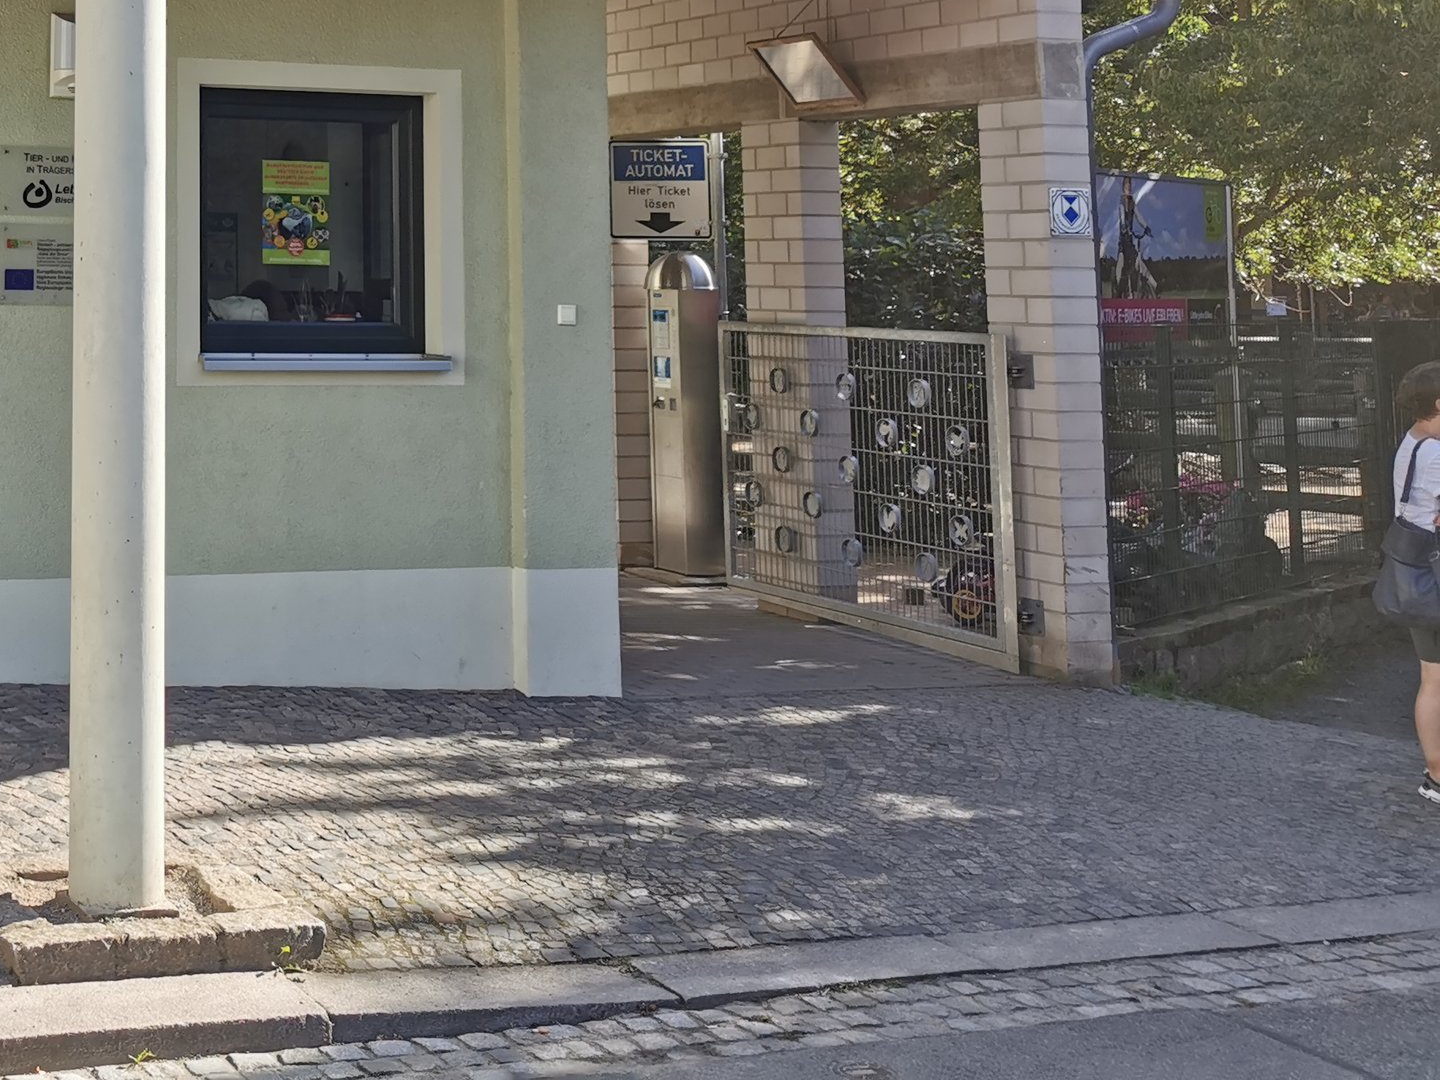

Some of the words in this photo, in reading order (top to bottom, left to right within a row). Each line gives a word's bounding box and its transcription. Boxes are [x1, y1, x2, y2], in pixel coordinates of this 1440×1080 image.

[23, 152, 44, 163] TIER
[51, 155, 69, 163] UND
[630, 149, 688, 162] TICKET-
[26, 166, 35, 174] IN
[625, 164, 694, 177] AUTOMAT
[628, 186, 652, 196] Hier
[657, 185, 691, 196] Ticket
[644, 199, 676, 209] lösen
